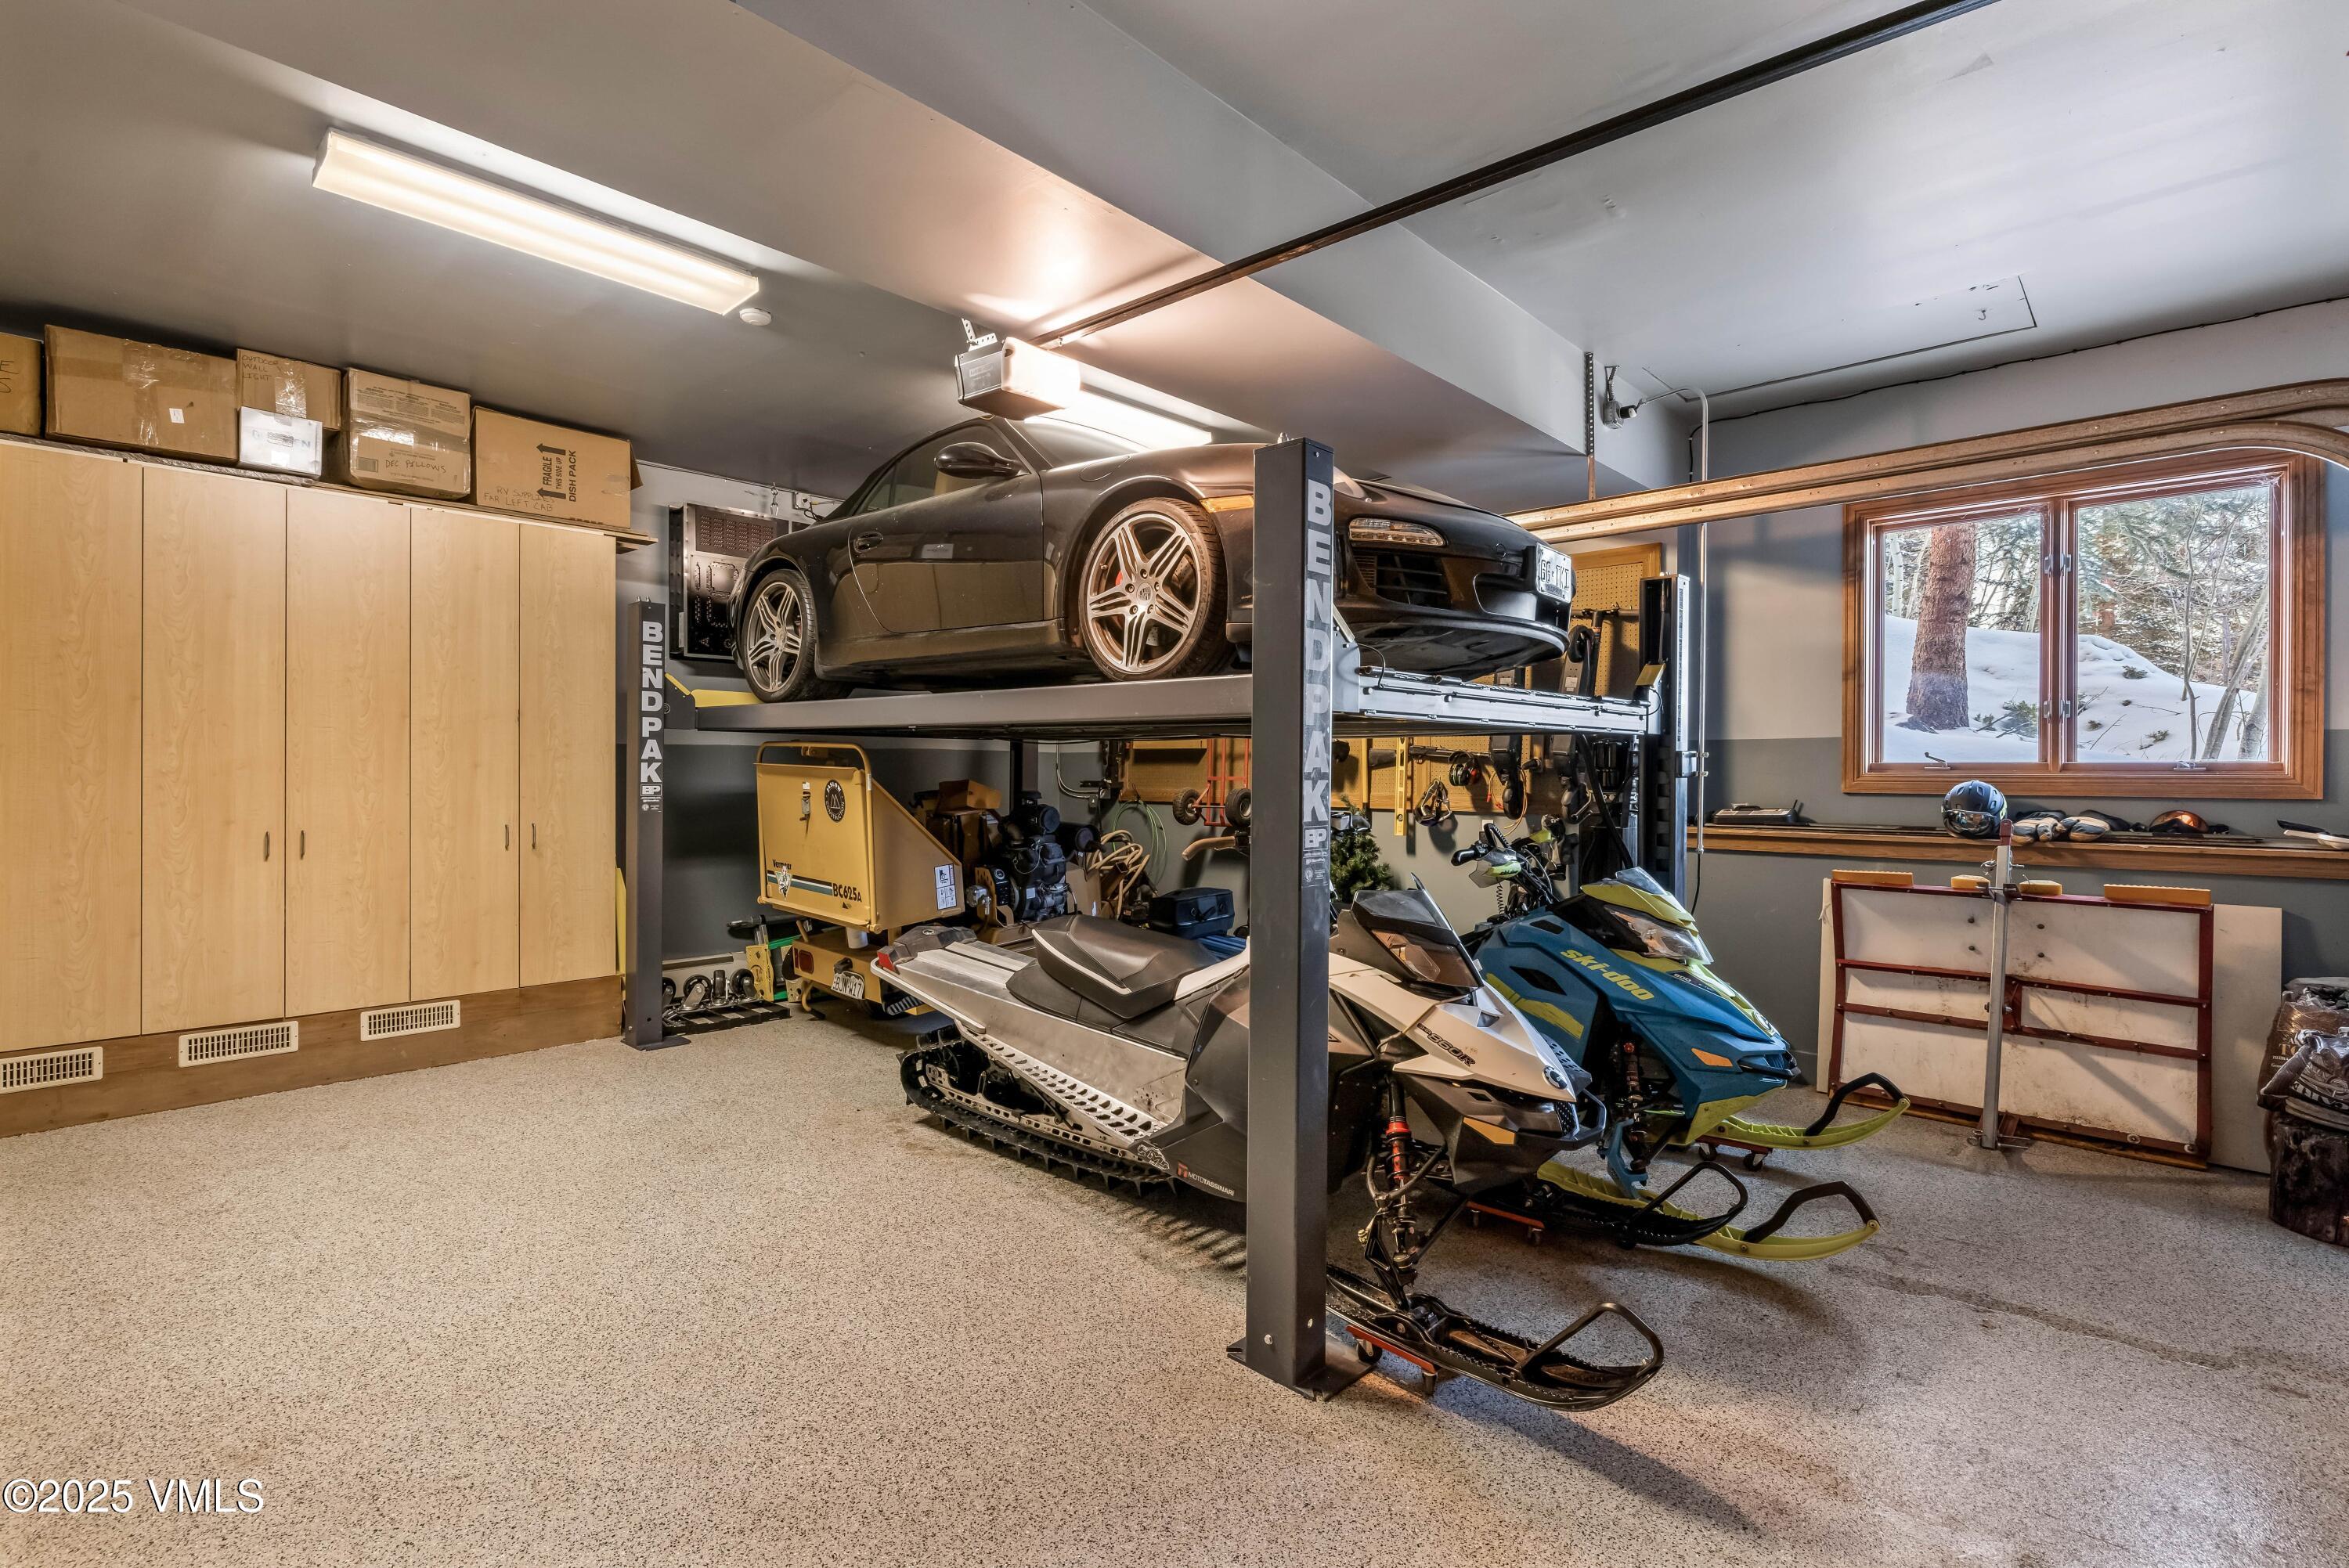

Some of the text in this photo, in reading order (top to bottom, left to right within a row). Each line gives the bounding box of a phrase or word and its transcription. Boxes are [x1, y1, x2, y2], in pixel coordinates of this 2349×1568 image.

[385, 460, 399, 468] DEC
[542, 456, 552, 486] FRAGILE
[568, 450, 577, 503] DISH PACK
[1303, 478, 1332, 822] BENDPAK
[640, 621, 663, 783] BENDPAK
[832, 882, 863, 903] BC625A
[1188, 1171, 1235, 1197] MOTOTASSINARI
